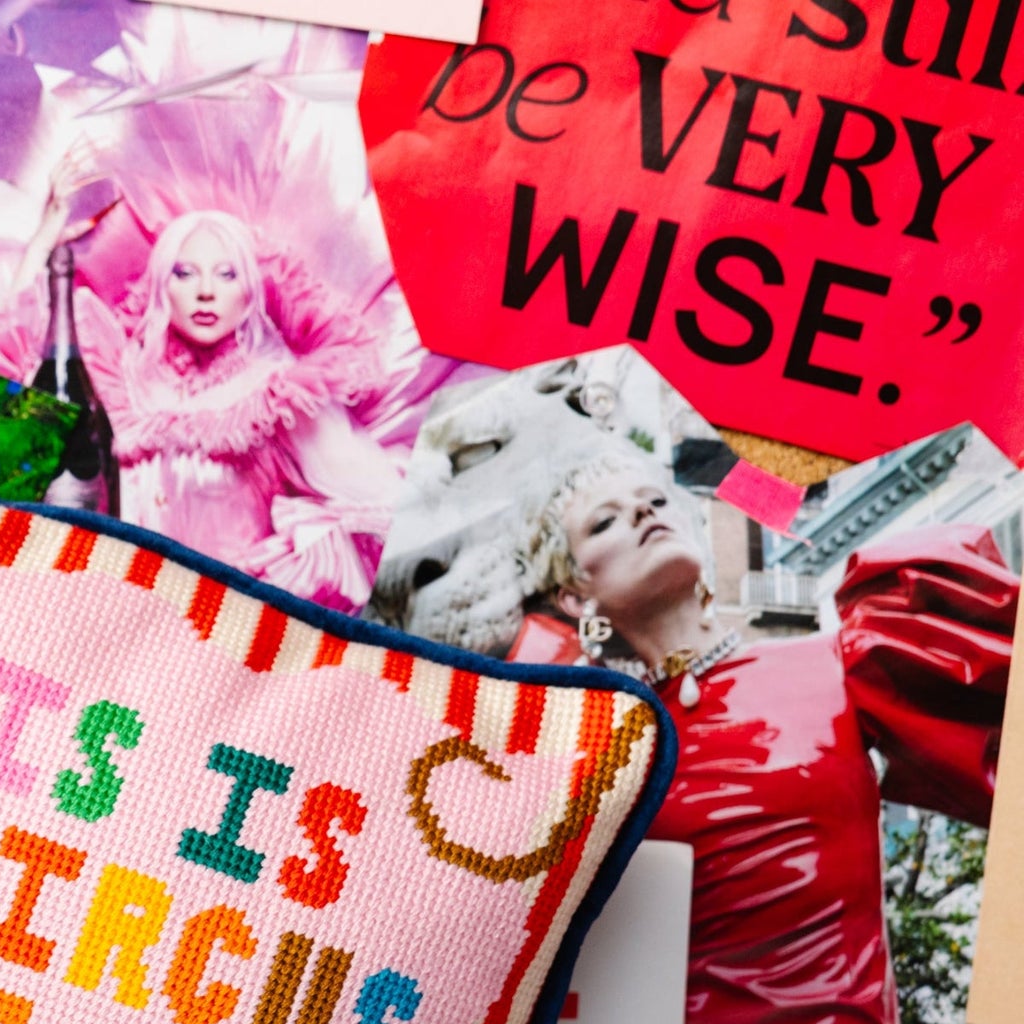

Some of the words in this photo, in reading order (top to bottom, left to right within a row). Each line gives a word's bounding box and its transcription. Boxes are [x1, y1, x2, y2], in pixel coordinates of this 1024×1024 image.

[420, 43, 589, 143] be
[633, 49, 994, 243] VERY
[176, 742, 368, 909] IS
